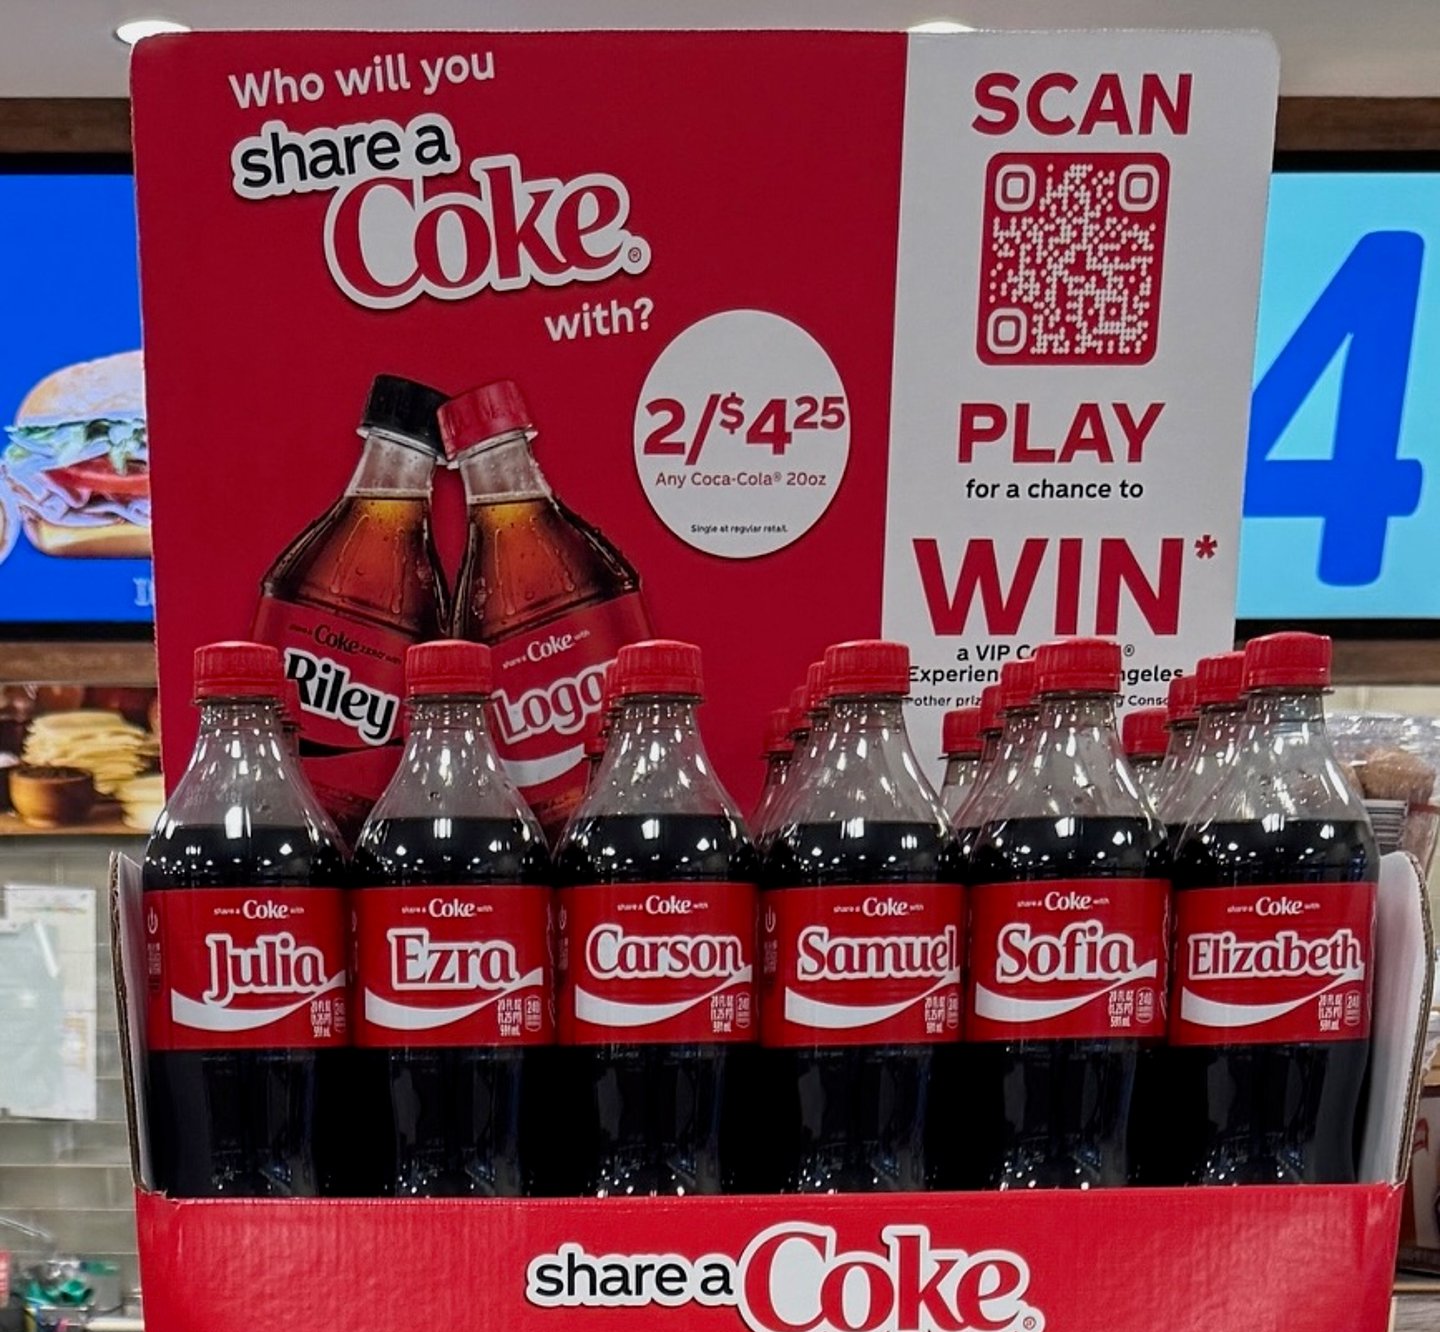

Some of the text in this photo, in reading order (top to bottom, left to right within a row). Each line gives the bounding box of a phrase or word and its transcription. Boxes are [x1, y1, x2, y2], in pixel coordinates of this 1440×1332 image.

[229, 52, 496, 110] Who will you
[971, 72, 1193, 136] SCAN
[238, 124, 452, 190] share a
[544, 297, 655, 342] with?
[1243, 229, 1425, 588] 4
[958, 402, 1166, 464] PLAY
[655, 472, 686, 489] Any
[786, 472, 827, 487] 20oz
[965, 477, 1144, 500] for a chance to
[690, 524, 718, 534] Single
[720, 524, 730, 533] at
[314, 623, 361, 655] Coke
[527, 633, 575, 663] Coke
[956, 648, 970, 661] a
[976, 644, 1011, 662] VIP
[908, 664, 999, 686] Experien
[285, 651, 397, 742] Riley
[955, 694, 983, 707] priz
[243, 899, 289, 920] Coke
[428, 897, 476, 918] Coke
[645, 895, 692, 915] Coke
[862, 897, 908, 917] Coke
[1045, 891, 1092, 911] Coke
[1256, 896, 1303, 916] Coke
[206, 935, 327, 1005] Julia
[391, 930, 519, 988] Ezra
[589, 925, 745, 977] Carson
[799, 925, 957, 978] Samuel
[999, 922, 1135, 980] Sofia
[1191, 929, 1364, 977] Elizabeth
[534, 1251, 688, 1299] share
[699, 1261, 734, 1297] a
